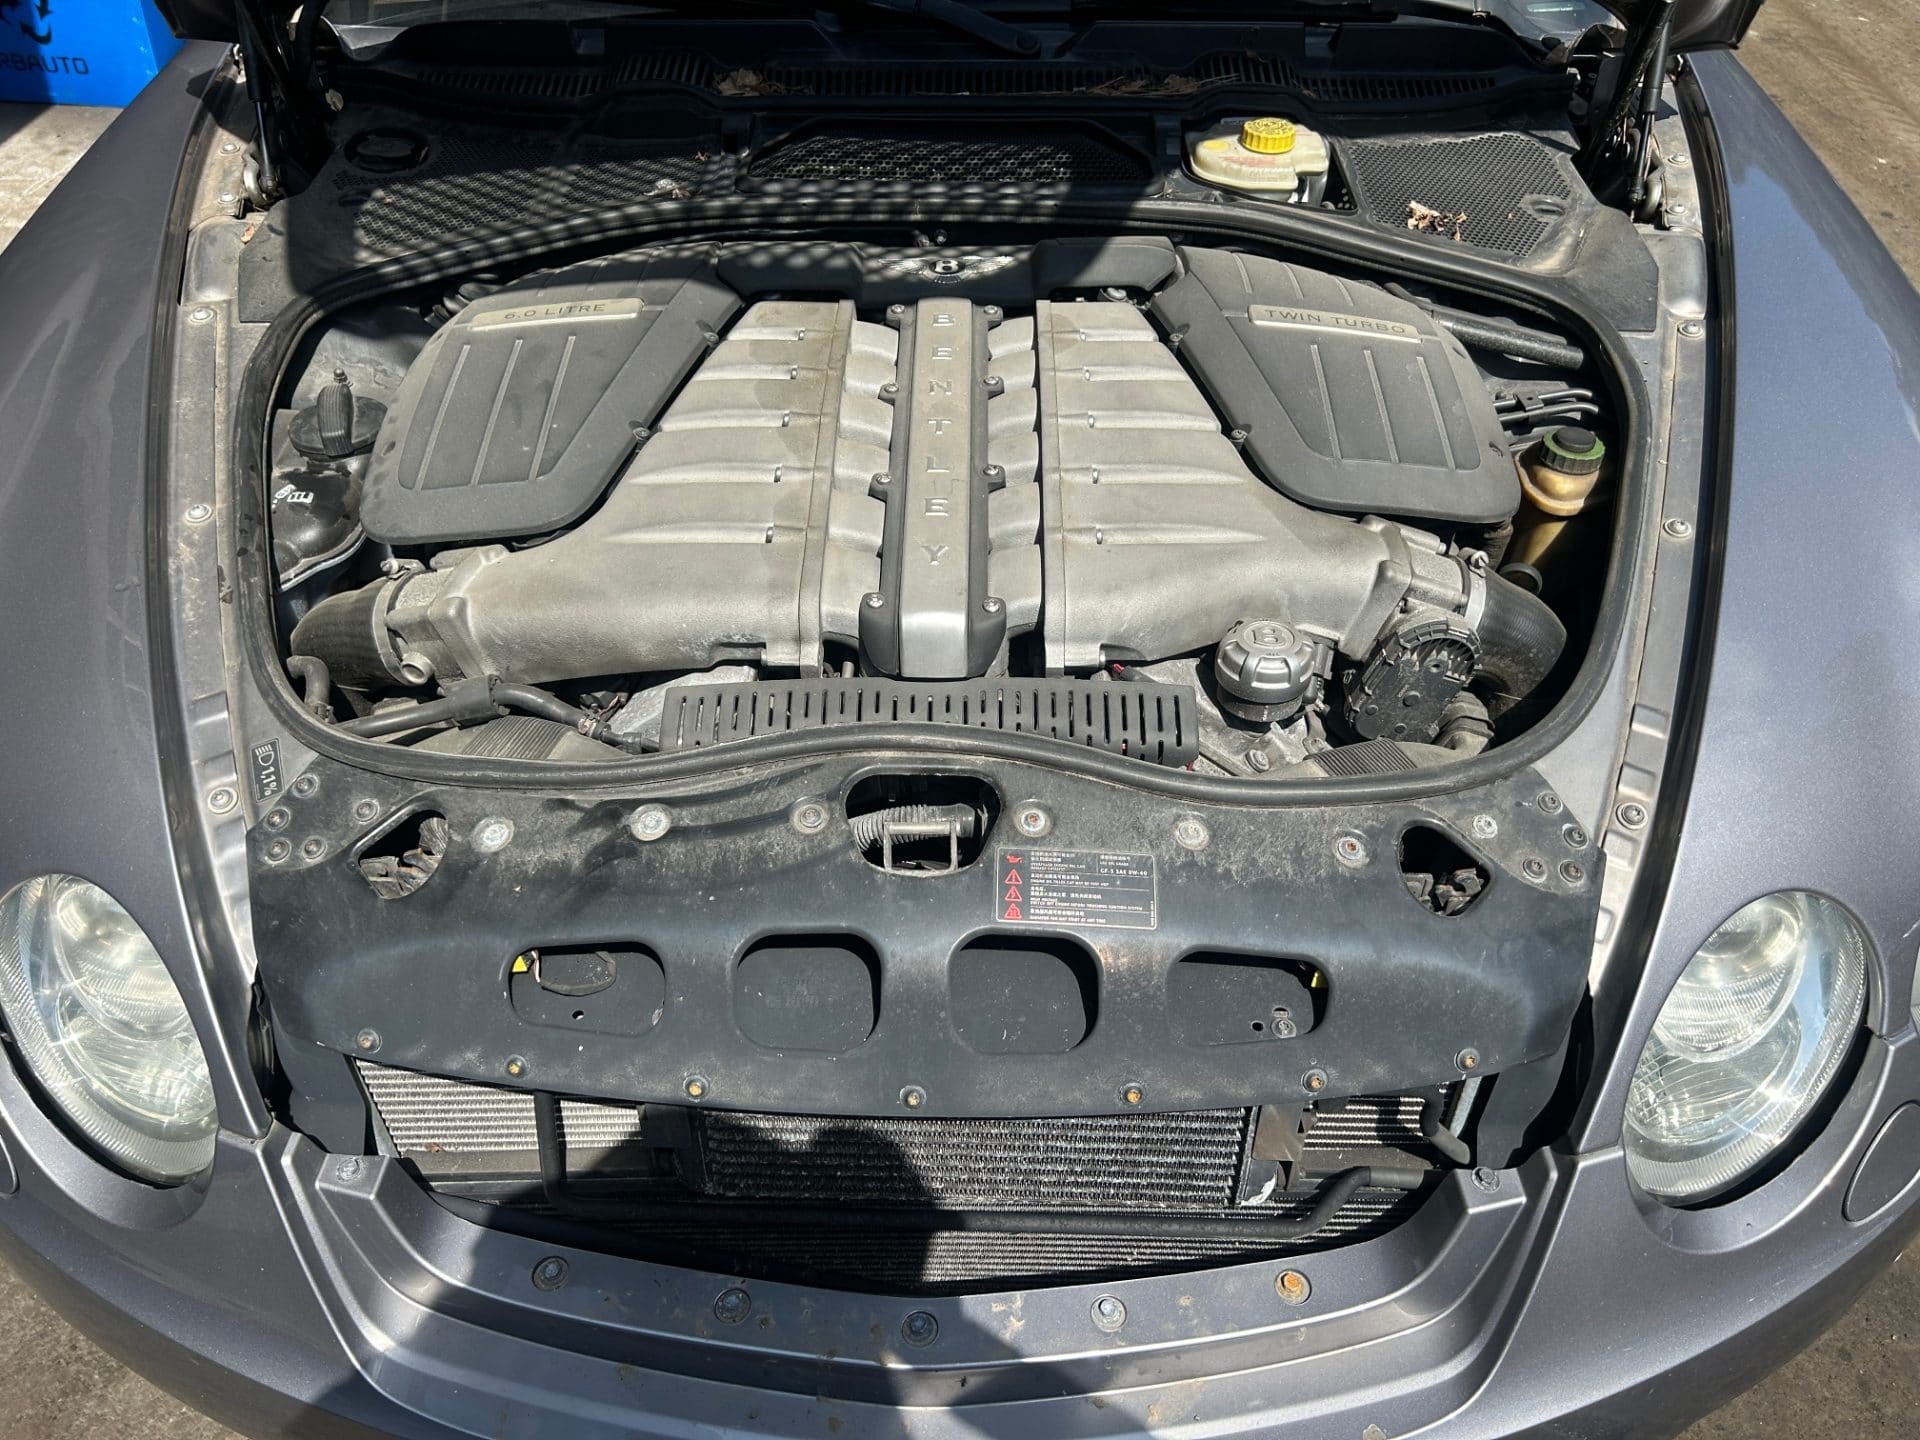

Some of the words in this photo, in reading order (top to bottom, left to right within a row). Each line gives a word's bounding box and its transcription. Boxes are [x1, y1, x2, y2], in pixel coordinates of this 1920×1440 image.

[503, 310, 537, 321] 6.0
[544, 302, 606, 316] LITRE
[1264, 308, 1322, 323] TWIN
[1330, 316, 1406, 335] TURBO
[921, 311, 955, 567] BENTLEY
